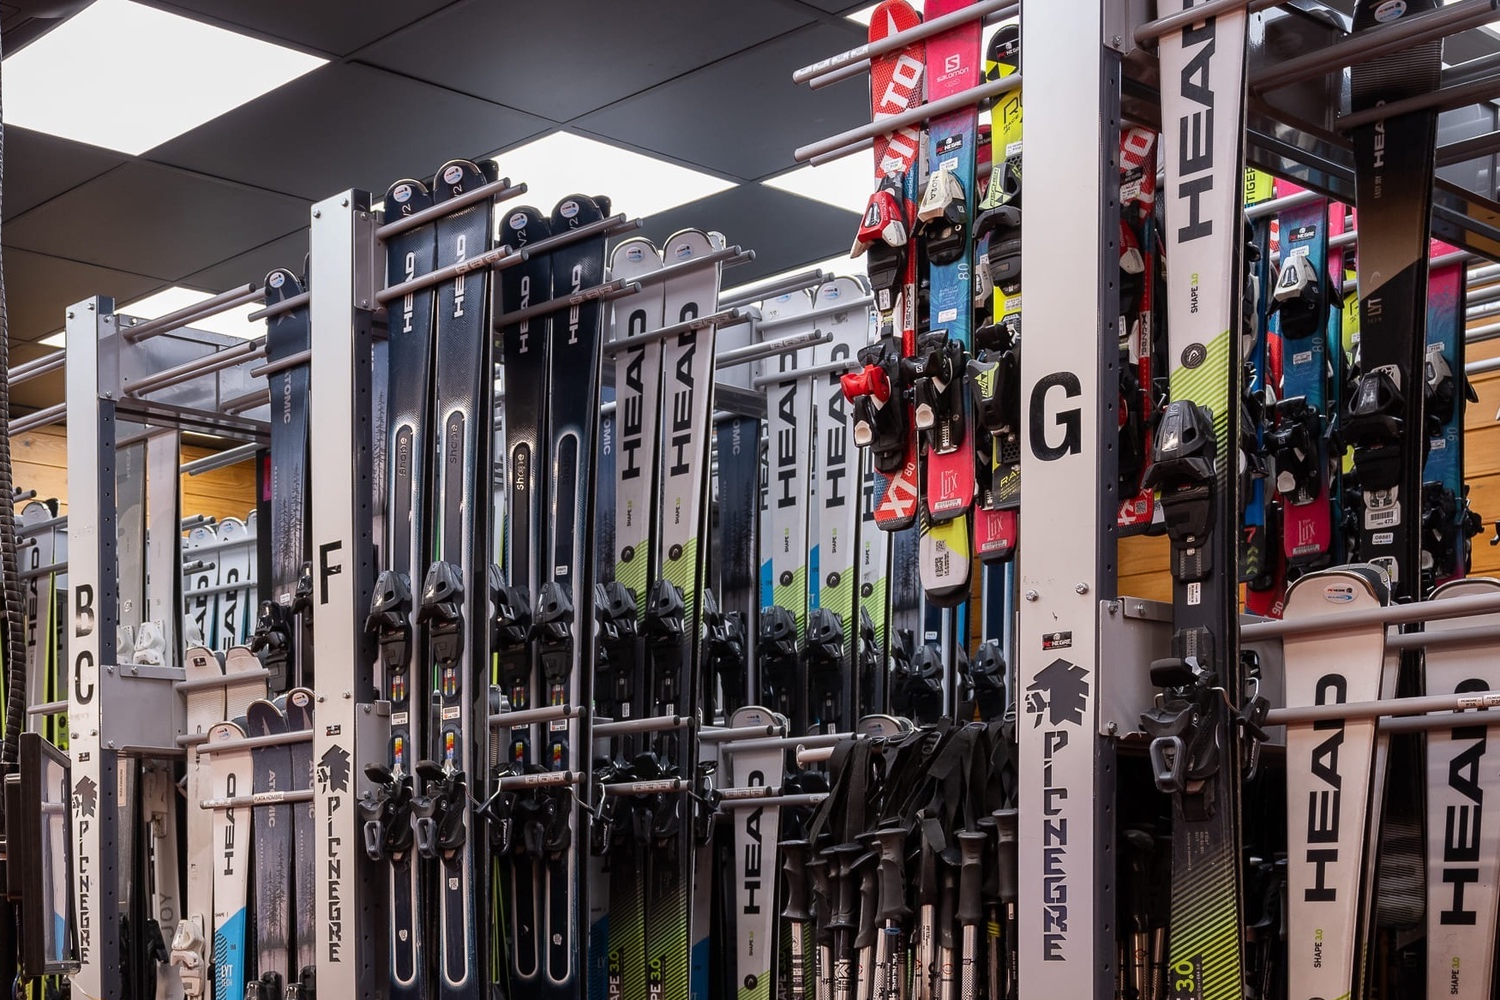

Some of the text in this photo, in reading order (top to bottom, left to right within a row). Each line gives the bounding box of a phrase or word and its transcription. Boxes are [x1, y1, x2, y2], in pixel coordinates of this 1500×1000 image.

[453, 234, 466, 318] HEAD
[957, 263, 970, 281] 80
[403, 252, 416, 334] HEAD
[1190, 273, 1199, 313] SHAPE 3.0
[1311, 337, 1324, 353] 80
[622, 308, 647, 480] HEAD
[670, 301, 699, 477] HEAD
[1028, 371, 1082, 462] G
[603, 418, 611, 456] OMIC
[732, 418, 740, 456] OMIC
[905, 462, 916, 477] 80
[1243, 526, 1257, 543] 7
[319, 540, 343, 605] F
[75, 584, 94, 638] B
[1272, 601, 1284, 616] 90
[75, 650, 94, 705] C
[268, 769, 276, 828] ATMIC
[1304, 673, 1347, 902] HEAD
[224, 773, 237, 876] HEAD
[743, 770, 765, 915] HEAD
[610, 950, 620, 971] 3.0
[1313, 928, 1323, 968] SHAPE 3.0
[651, 957, 661, 980] 3.0
[1175, 960, 1195, 992] 3.0
[1450, 956, 1460, 995] SHAPE 3.0
